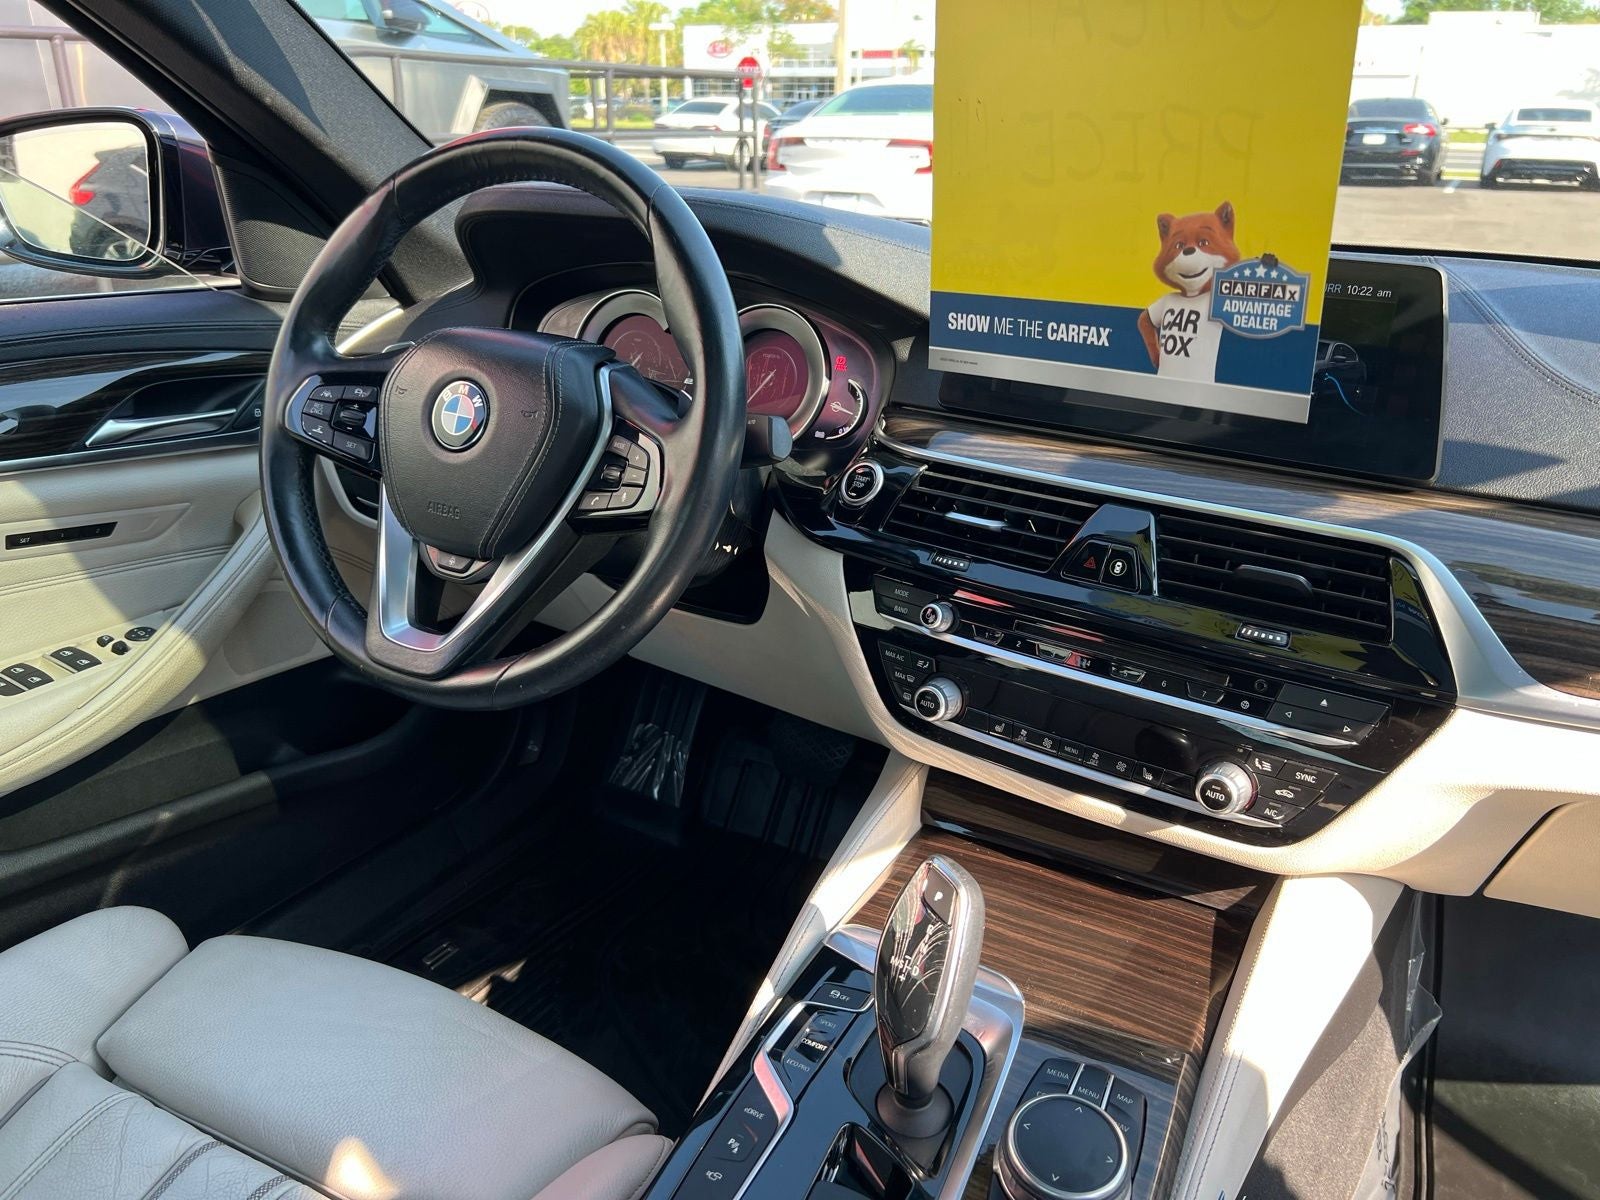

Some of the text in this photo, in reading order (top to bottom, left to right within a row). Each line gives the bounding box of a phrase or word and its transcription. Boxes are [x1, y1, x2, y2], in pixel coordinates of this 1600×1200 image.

[1220, 280, 1299, 301] CARFAX
[1324, 283, 1392, 298] RR 10:22 am
[1223, 300, 1292, 318] ADVANTAGE
[1162, 308, 1200, 333] CAR
[1233, 315, 1278, 331] DEALER
[948, 312, 1110, 347] SHOW ME THE CARFAX
[346, 440, 357, 449] SET
[854, 475, 870, 483] START
[427, 500, 461, 520] AIRBAG
[894, 588, 909, 598] MODE
[885, 650, 897, 659] MAX
[895, 671, 906, 680] MAX
[920, 699, 935, 709] AUTO
[1064, 745, 1079, 755] MENU
[1295, 772, 1318, 783] SYNC
[1205, 789, 1226, 802] AUTO
[1263, 807, 1278, 818] A/C
[934, 891, 944, 901] P
[912, 966, 920, 977] D
[839, 994, 850, 1002] OFF
[819, 1018, 838, 1029] SPORT
[800, 1037, 828, 1052] COMFORT
[786, 1058, 811, 1073] ECO PRO
[1046, 1068, 1070, 1080] MEDIA
[1078, 1086, 1100, 1100] MENU
[1116, 1093, 1134, 1105] MAP
[744, 1107, 766, 1120] eDRIVE
